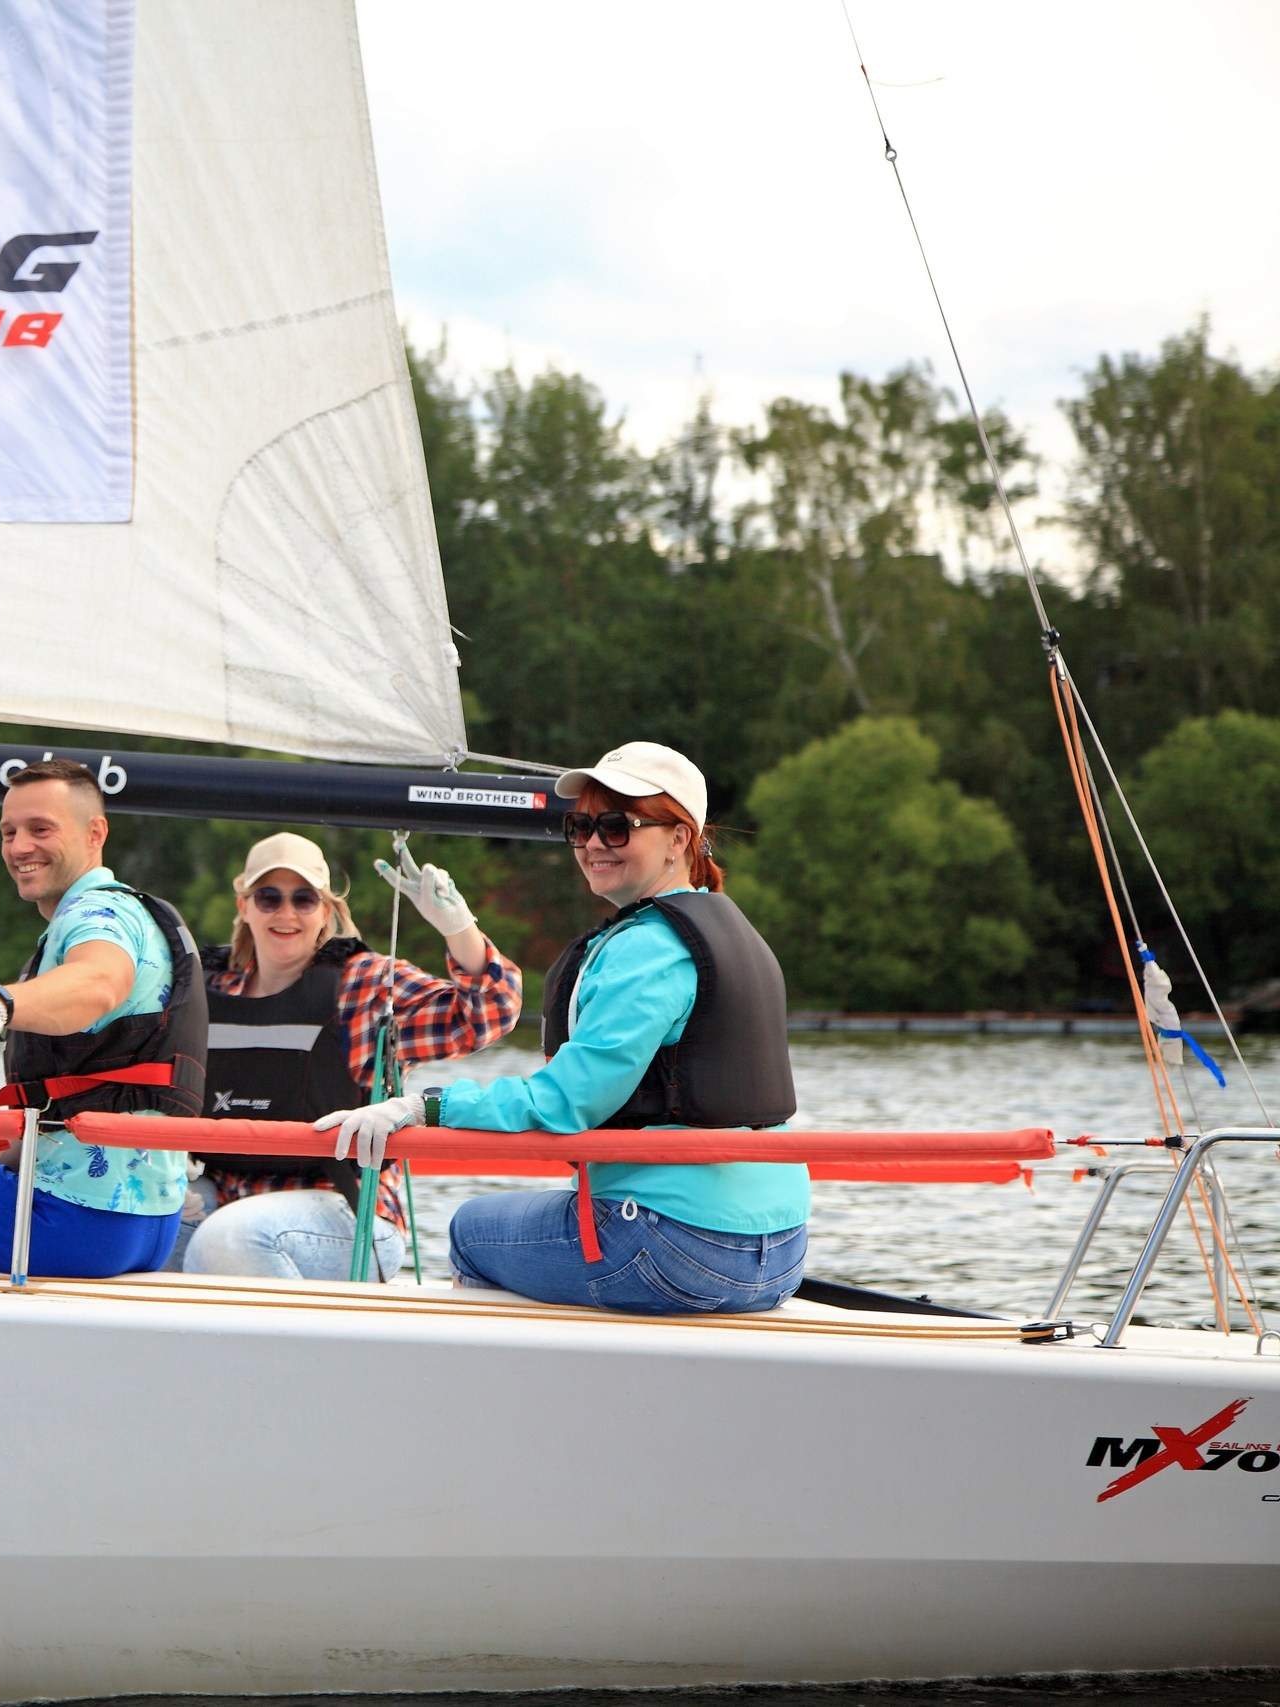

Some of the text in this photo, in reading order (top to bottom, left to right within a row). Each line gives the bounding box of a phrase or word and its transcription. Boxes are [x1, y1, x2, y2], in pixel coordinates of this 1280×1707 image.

[417, 790, 527, 805] WIND BROTHERS
[1209, 1441, 1272, 1450] SAILING
